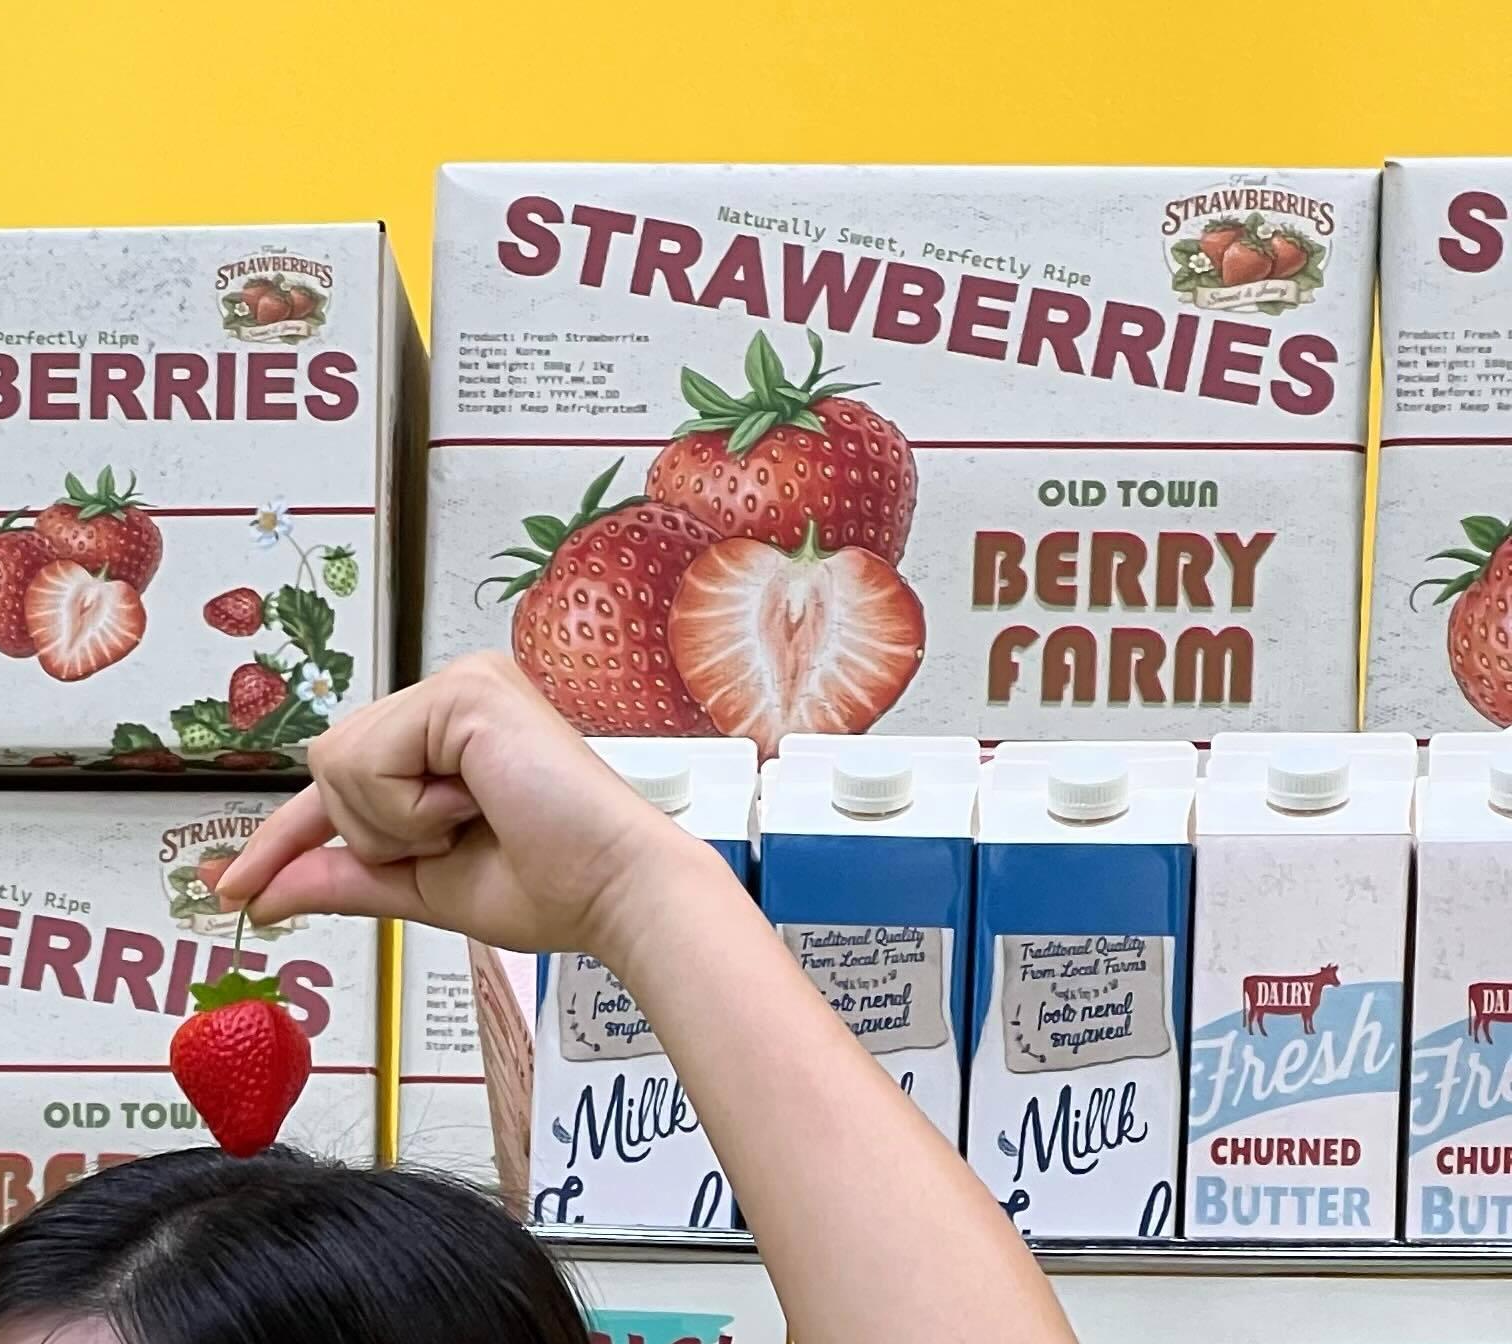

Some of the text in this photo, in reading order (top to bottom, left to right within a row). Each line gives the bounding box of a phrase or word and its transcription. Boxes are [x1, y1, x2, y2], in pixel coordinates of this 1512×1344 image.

[1162, 189, 1334, 236] STRAWBERRIES
[717, 205, 1092, 287] Naturally Sweet, Perfectly Ripe
[215, 256, 333, 290] STRAWBERRIES
[497, 195, 1339, 415] STRAWBERRIES
[98, 331, 139, 347] Ripe
[1038, 480, 1218, 508] OLD TOWN
[971, 531, 1277, 612] BERRY
[987, 626, 1254, 708] FARM
[44, 891, 91, 915] Ripe
[801, 948, 925, 969] From Local Farms
[1020, 957, 1146, 981] From Local Farms
[1256, 981, 1314, 1007] DAIRY
[1189, 992, 1395, 1127] Fresh
[43, 1102, 210, 1130] OLD TOW
[1210, 1137, 1361, 1166] CHURNED
